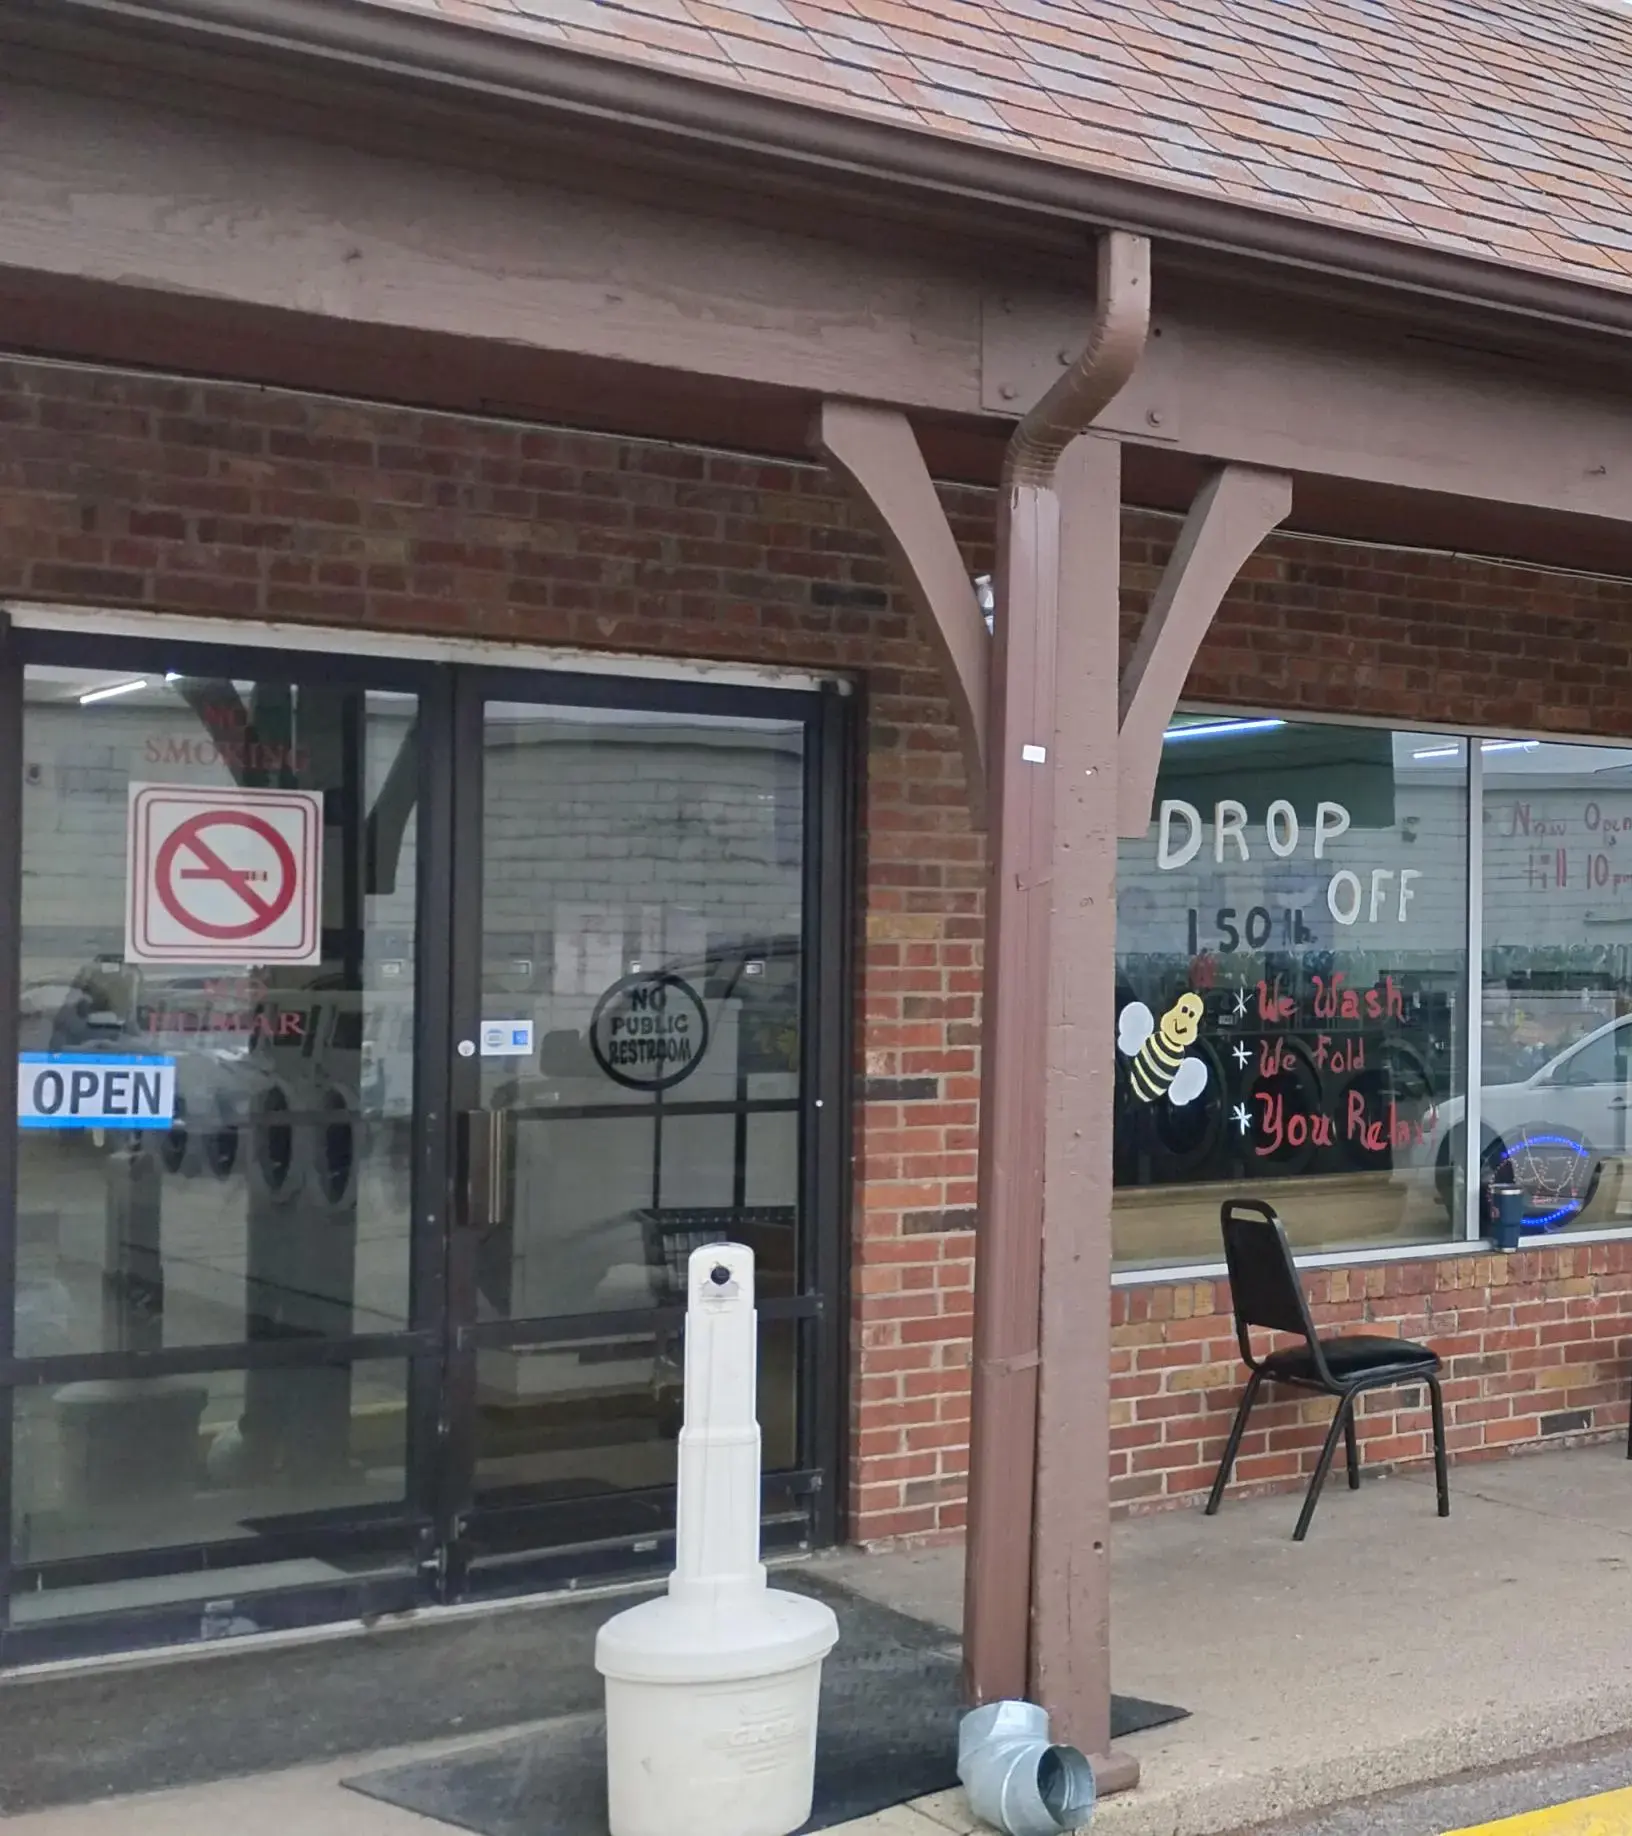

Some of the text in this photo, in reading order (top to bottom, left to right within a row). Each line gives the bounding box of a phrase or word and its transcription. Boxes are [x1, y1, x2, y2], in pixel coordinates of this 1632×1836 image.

[143, 735, 311, 774] SMOKING
[1157, 800, 1350, 870] DROP
[1584, 802, 1632, 848] Open
[1326, 869, 1423, 926] OFF
[630, 986, 667, 1012] NO
[1256, 972, 1407, 1024] We Wash
[611, 1013, 689, 1036] PUBLIC
[608, 1037, 692, 1065] RESTROOM
[1259, 1033, 1366, 1079] We Fold
[32, 1069, 161, 1115] OPEN
[1255, 1090, 1334, 1157] You
